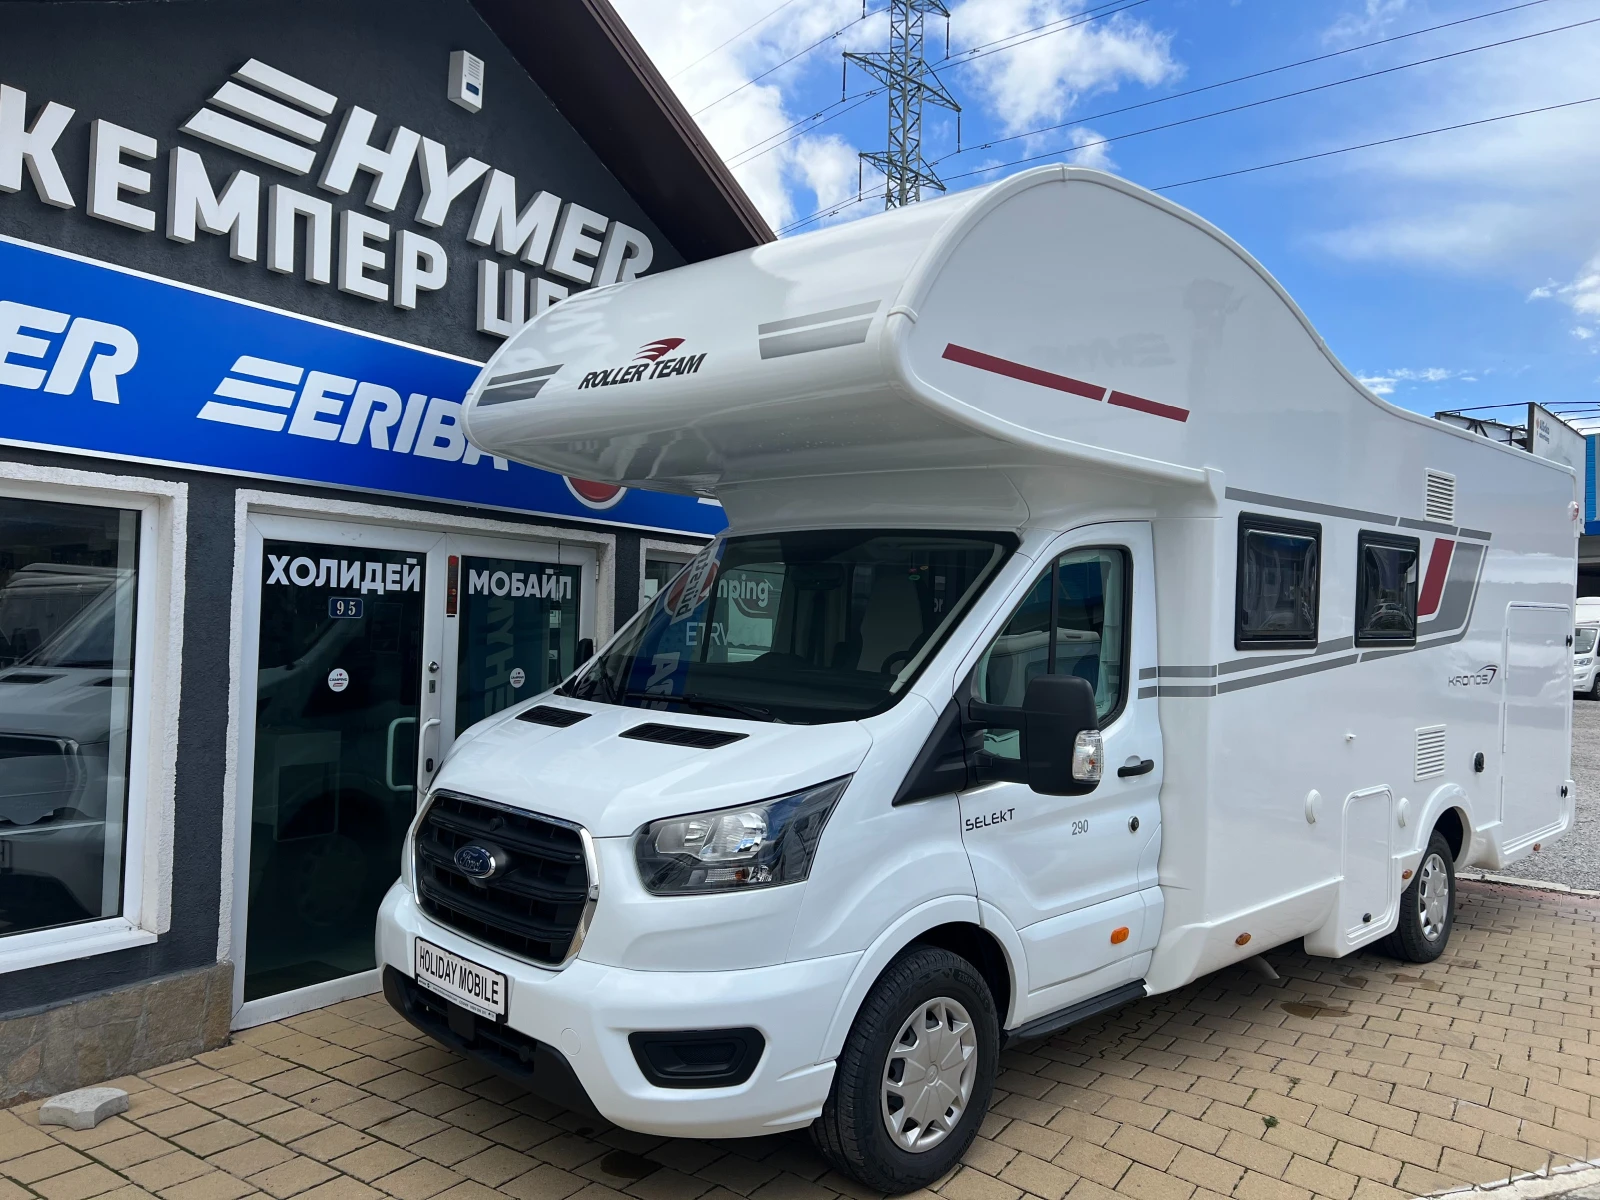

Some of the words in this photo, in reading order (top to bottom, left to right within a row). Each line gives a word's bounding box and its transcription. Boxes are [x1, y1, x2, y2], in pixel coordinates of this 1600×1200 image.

[0, 84, 448, 310] КЕМПЕР
[318, 106, 654, 288] HYMER
[578, 362, 650, 390] ROLLER
[648, 352, 708, 380] TEAM
[266, 554, 421, 595] ХОЛИДЕЙ
[468, 569, 572, 601] МОБАЙЛ
[336, 601, 357, 618] 95
[1448, 674, 1488, 687] KRONOS
[965, 807, 1016, 832] SELEKT
[1071, 819, 1089, 836] 290
[419, 945, 457, 985] HOLIDAY
[458, 967, 499, 1005] MOBILE
